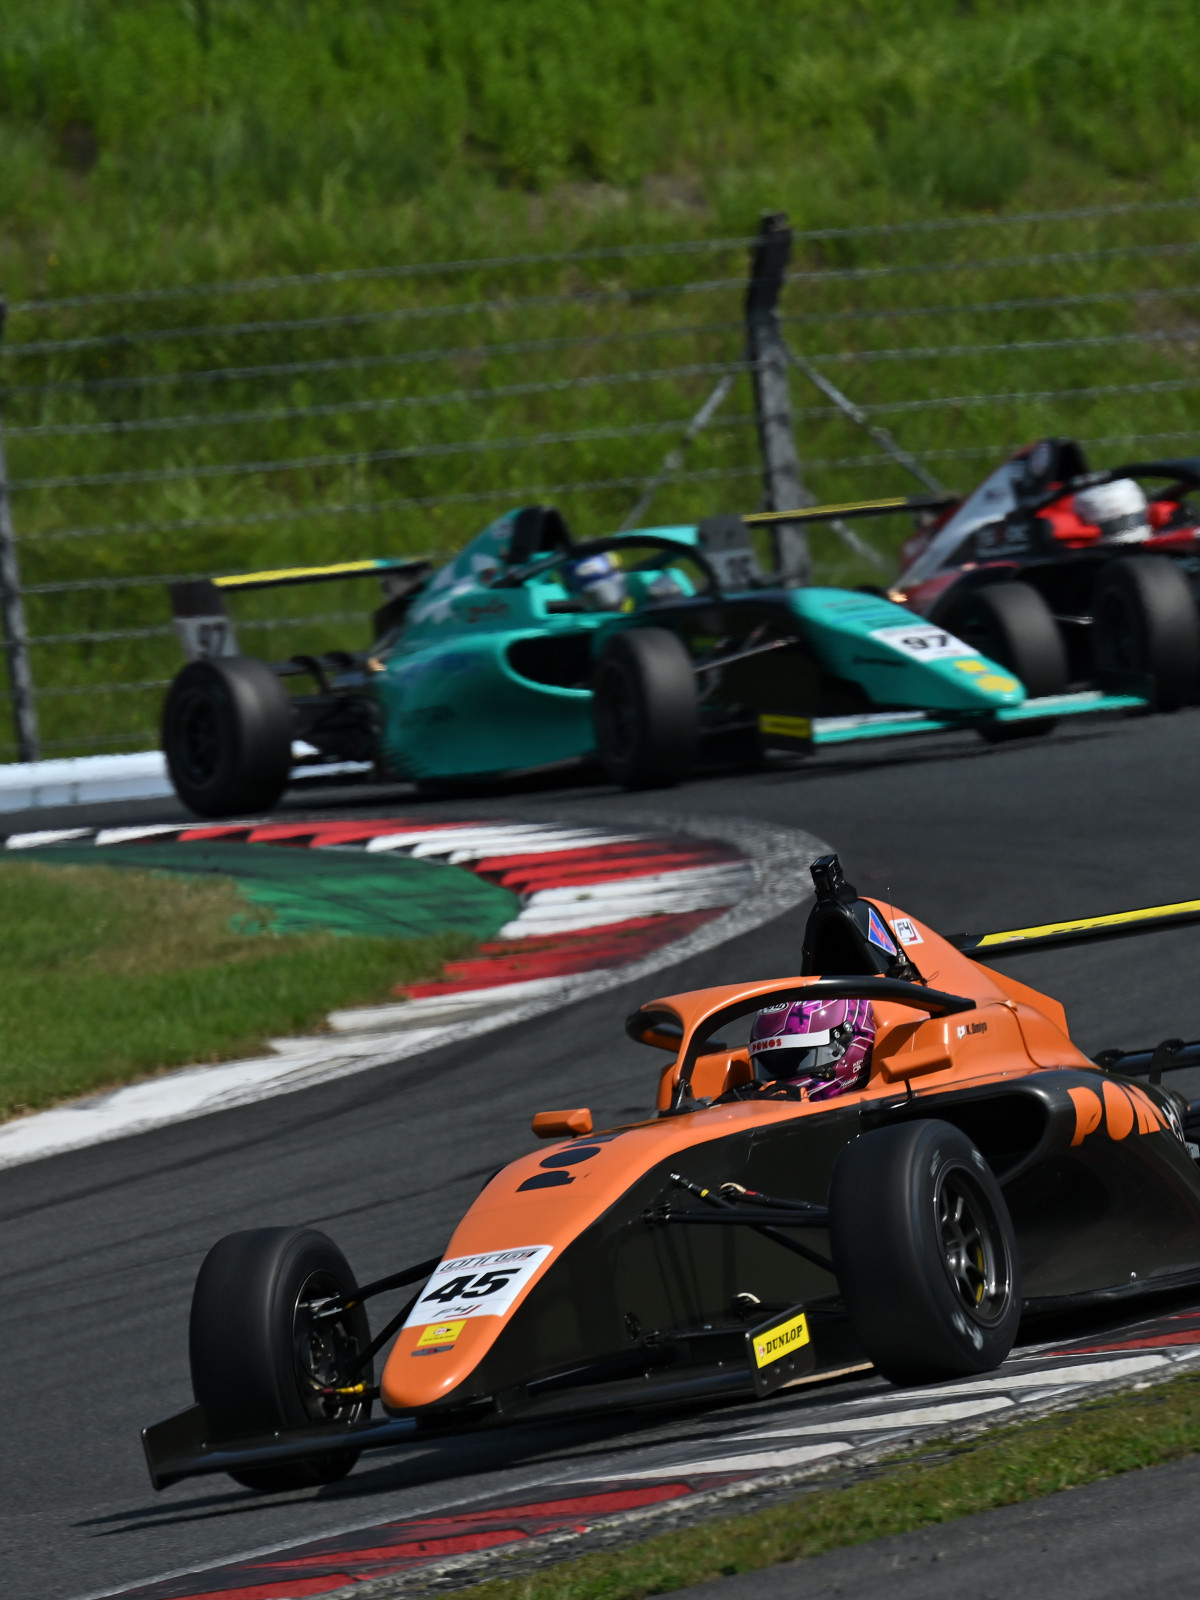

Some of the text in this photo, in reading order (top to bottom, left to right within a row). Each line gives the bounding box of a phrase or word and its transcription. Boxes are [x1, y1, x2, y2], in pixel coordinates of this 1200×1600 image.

[902, 634, 948, 650] 97
[752, 1039, 783, 1052] PONOS
[420, 1268, 523, 1304] 45
[766, 1325, 803, 1354] DUNLOP
